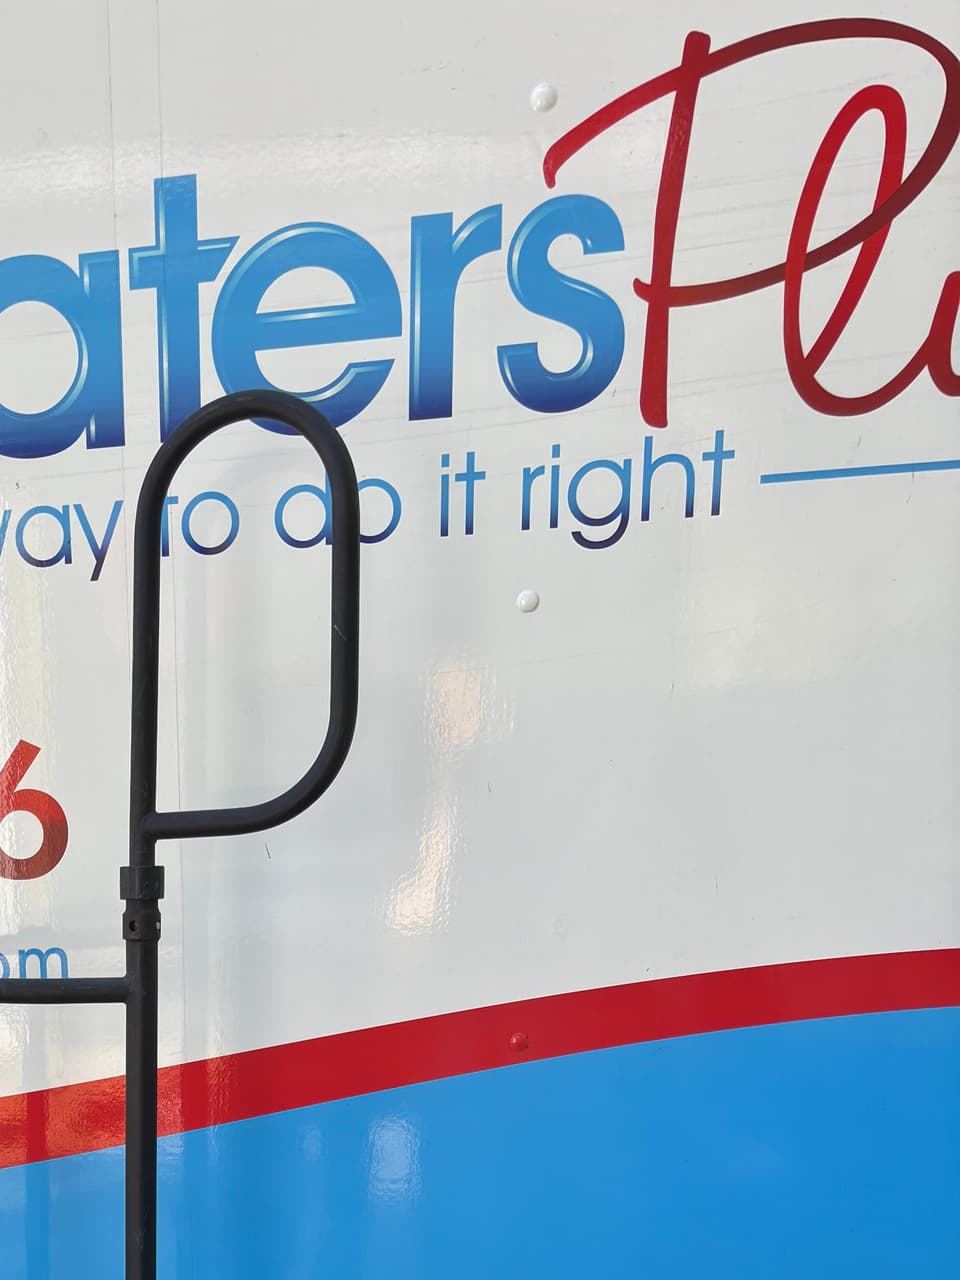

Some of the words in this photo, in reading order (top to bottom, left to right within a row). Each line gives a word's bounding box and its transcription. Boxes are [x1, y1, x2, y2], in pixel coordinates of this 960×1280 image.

[158, 491, 240, 556] to
[274, 470, 402, 549] do
[440, 451, 486, 538] it
[520, 430, 736, 550] right
